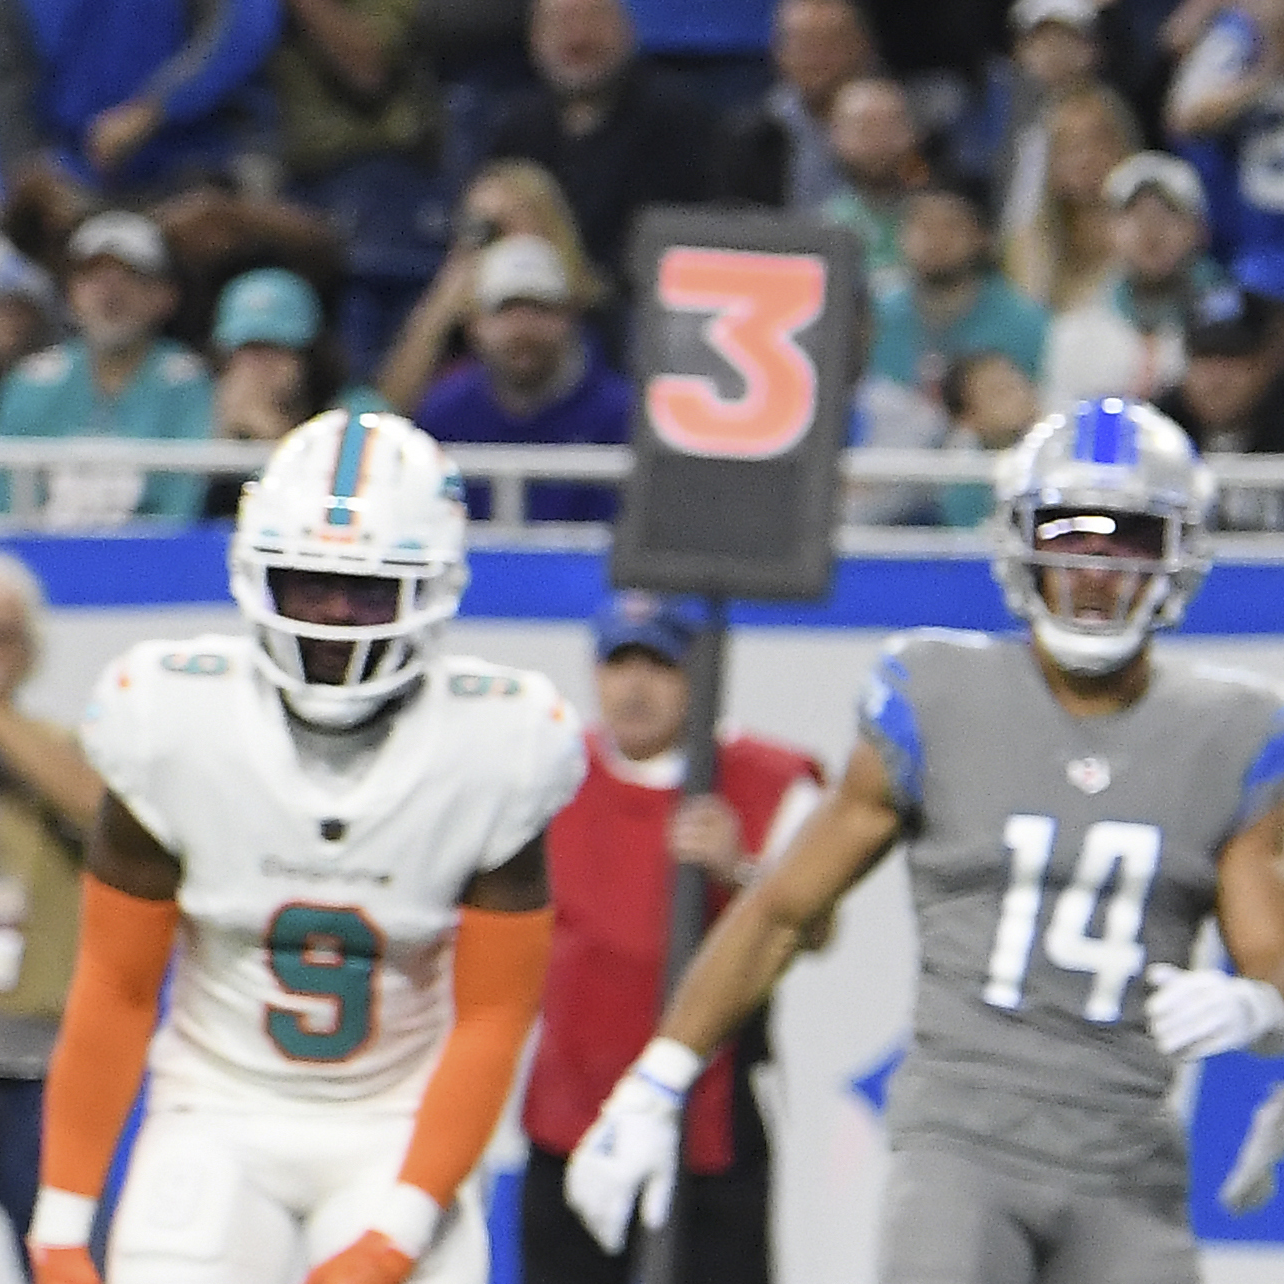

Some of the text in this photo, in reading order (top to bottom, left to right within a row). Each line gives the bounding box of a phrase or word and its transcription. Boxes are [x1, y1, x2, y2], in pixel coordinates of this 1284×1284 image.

[645, 246, 828, 461] 3
[264, 898, 391, 1066] 9
[982, 812, 1164, 1024] 14
